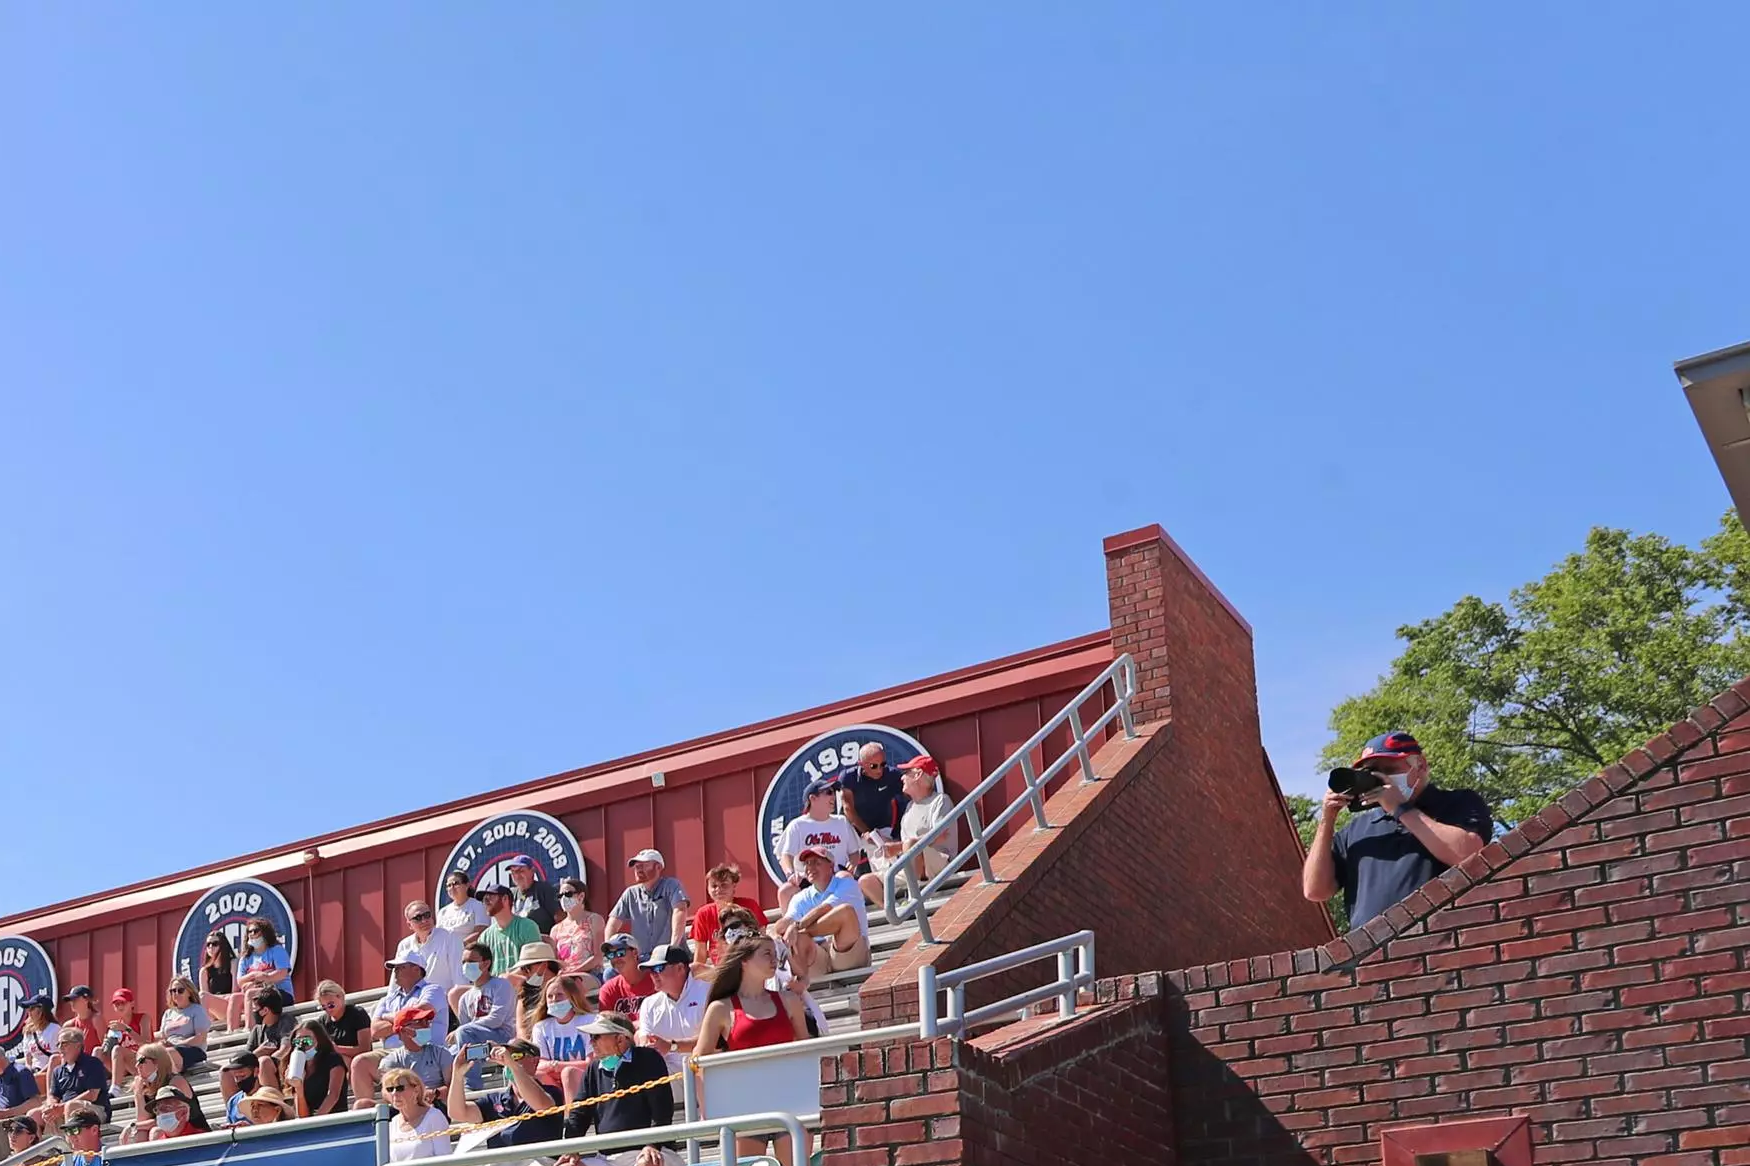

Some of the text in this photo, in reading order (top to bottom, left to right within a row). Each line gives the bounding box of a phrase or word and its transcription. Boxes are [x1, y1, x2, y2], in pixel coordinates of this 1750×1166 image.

[803, 741, 884, 782] 199
[482, 821, 530, 846] 2008,
[533, 827, 567, 870] 2009
[205, 892, 262, 923] 2009
